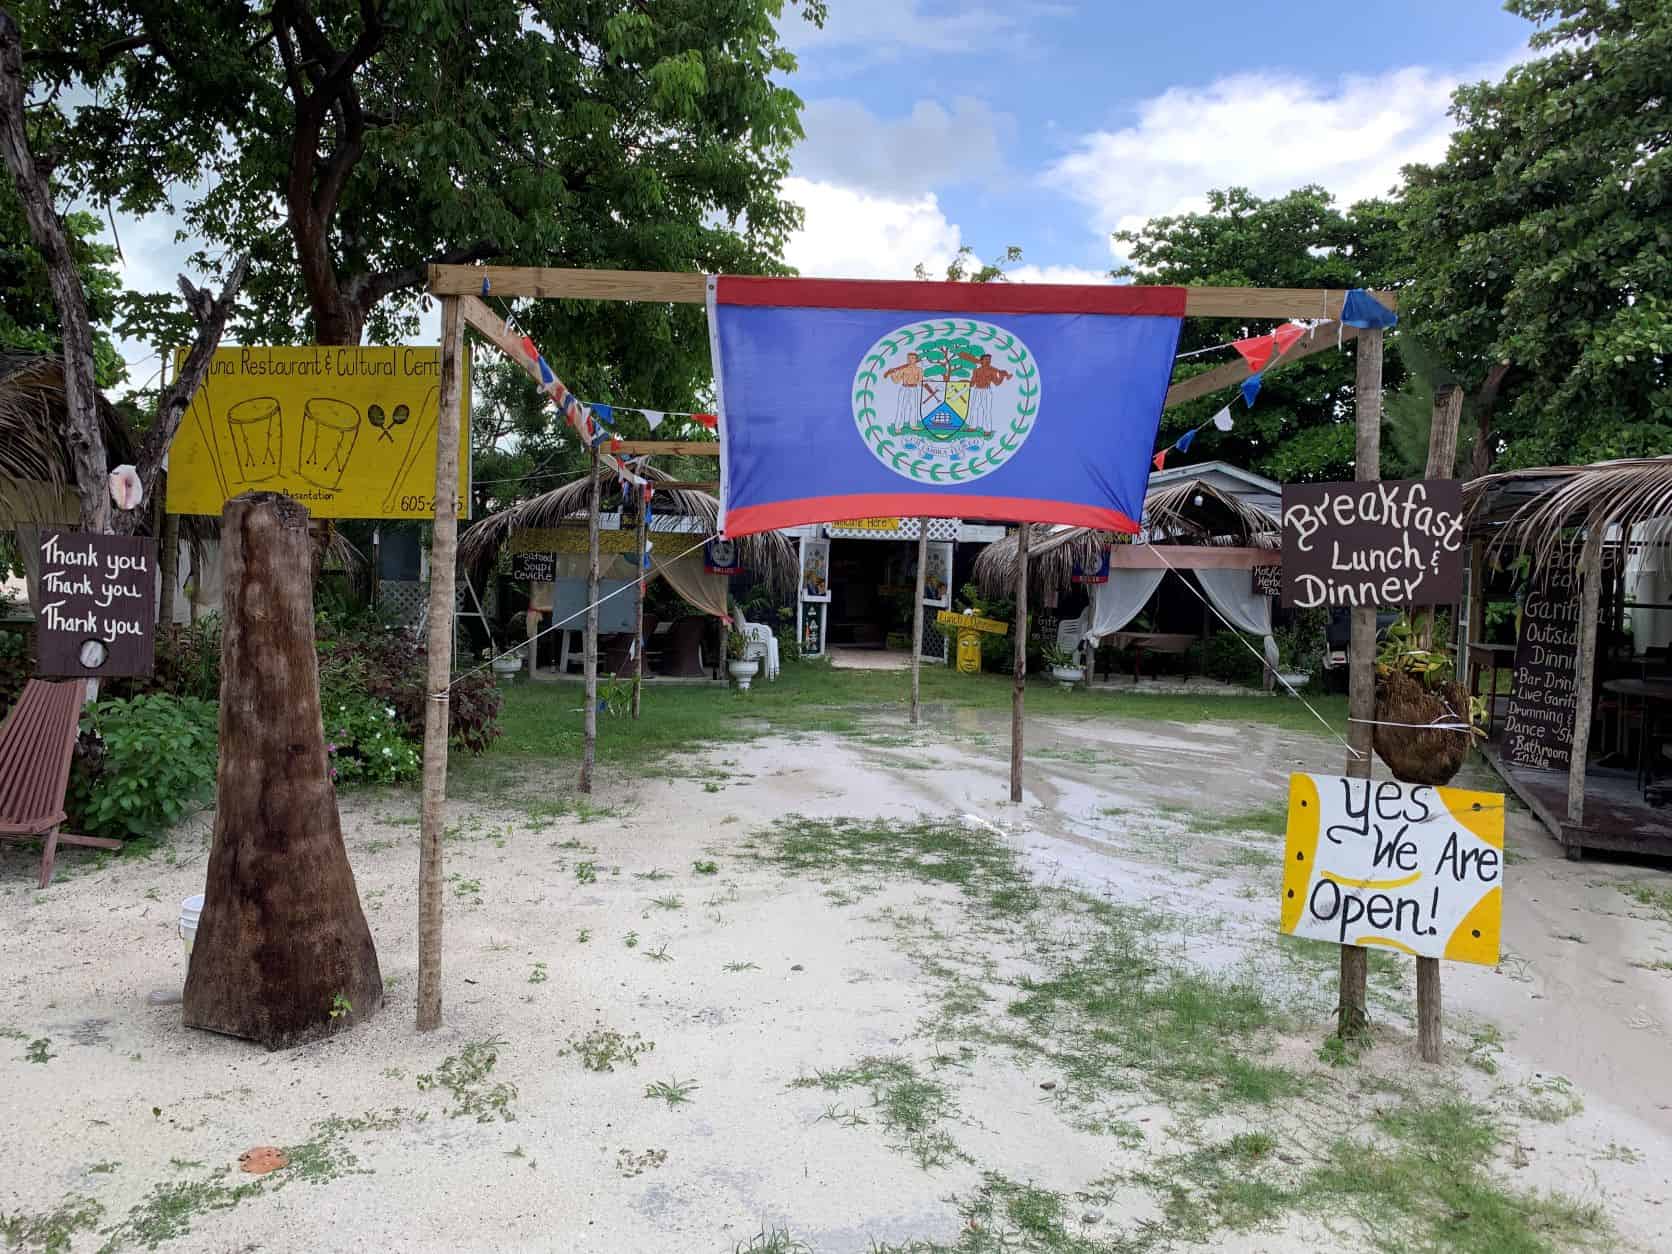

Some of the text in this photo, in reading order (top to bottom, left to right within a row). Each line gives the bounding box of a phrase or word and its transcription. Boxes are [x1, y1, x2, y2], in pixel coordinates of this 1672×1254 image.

[241, 348, 322, 377] Restaurant
[324, 350, 333, 376] &
[336, 348, 397, 377] Cultural
[1284, 483, 1463, 551] Breakfast
[41, 534, 147, 579] Thank you
[1331, 531, 1441, 575] Lunch &
[42, 570, 142, 607] Thank you
[1294, 571, 1424, 607] Dinner
[41, 600, 144, 642] Thank you
[1526, 622, 1578, 645] Outsid
[1518, 686, 1542, 702] Live
[1519, 666, 1541, 686] Bar
[1504, 716, 1546, 738] Dance
[1508, 701, 1563, 733] Drumming
[1512, 735, 1569, 763] Bathroom
[1372, 824, 1499, 882] We Are
[1310, 878, 1439, 942] Open!
